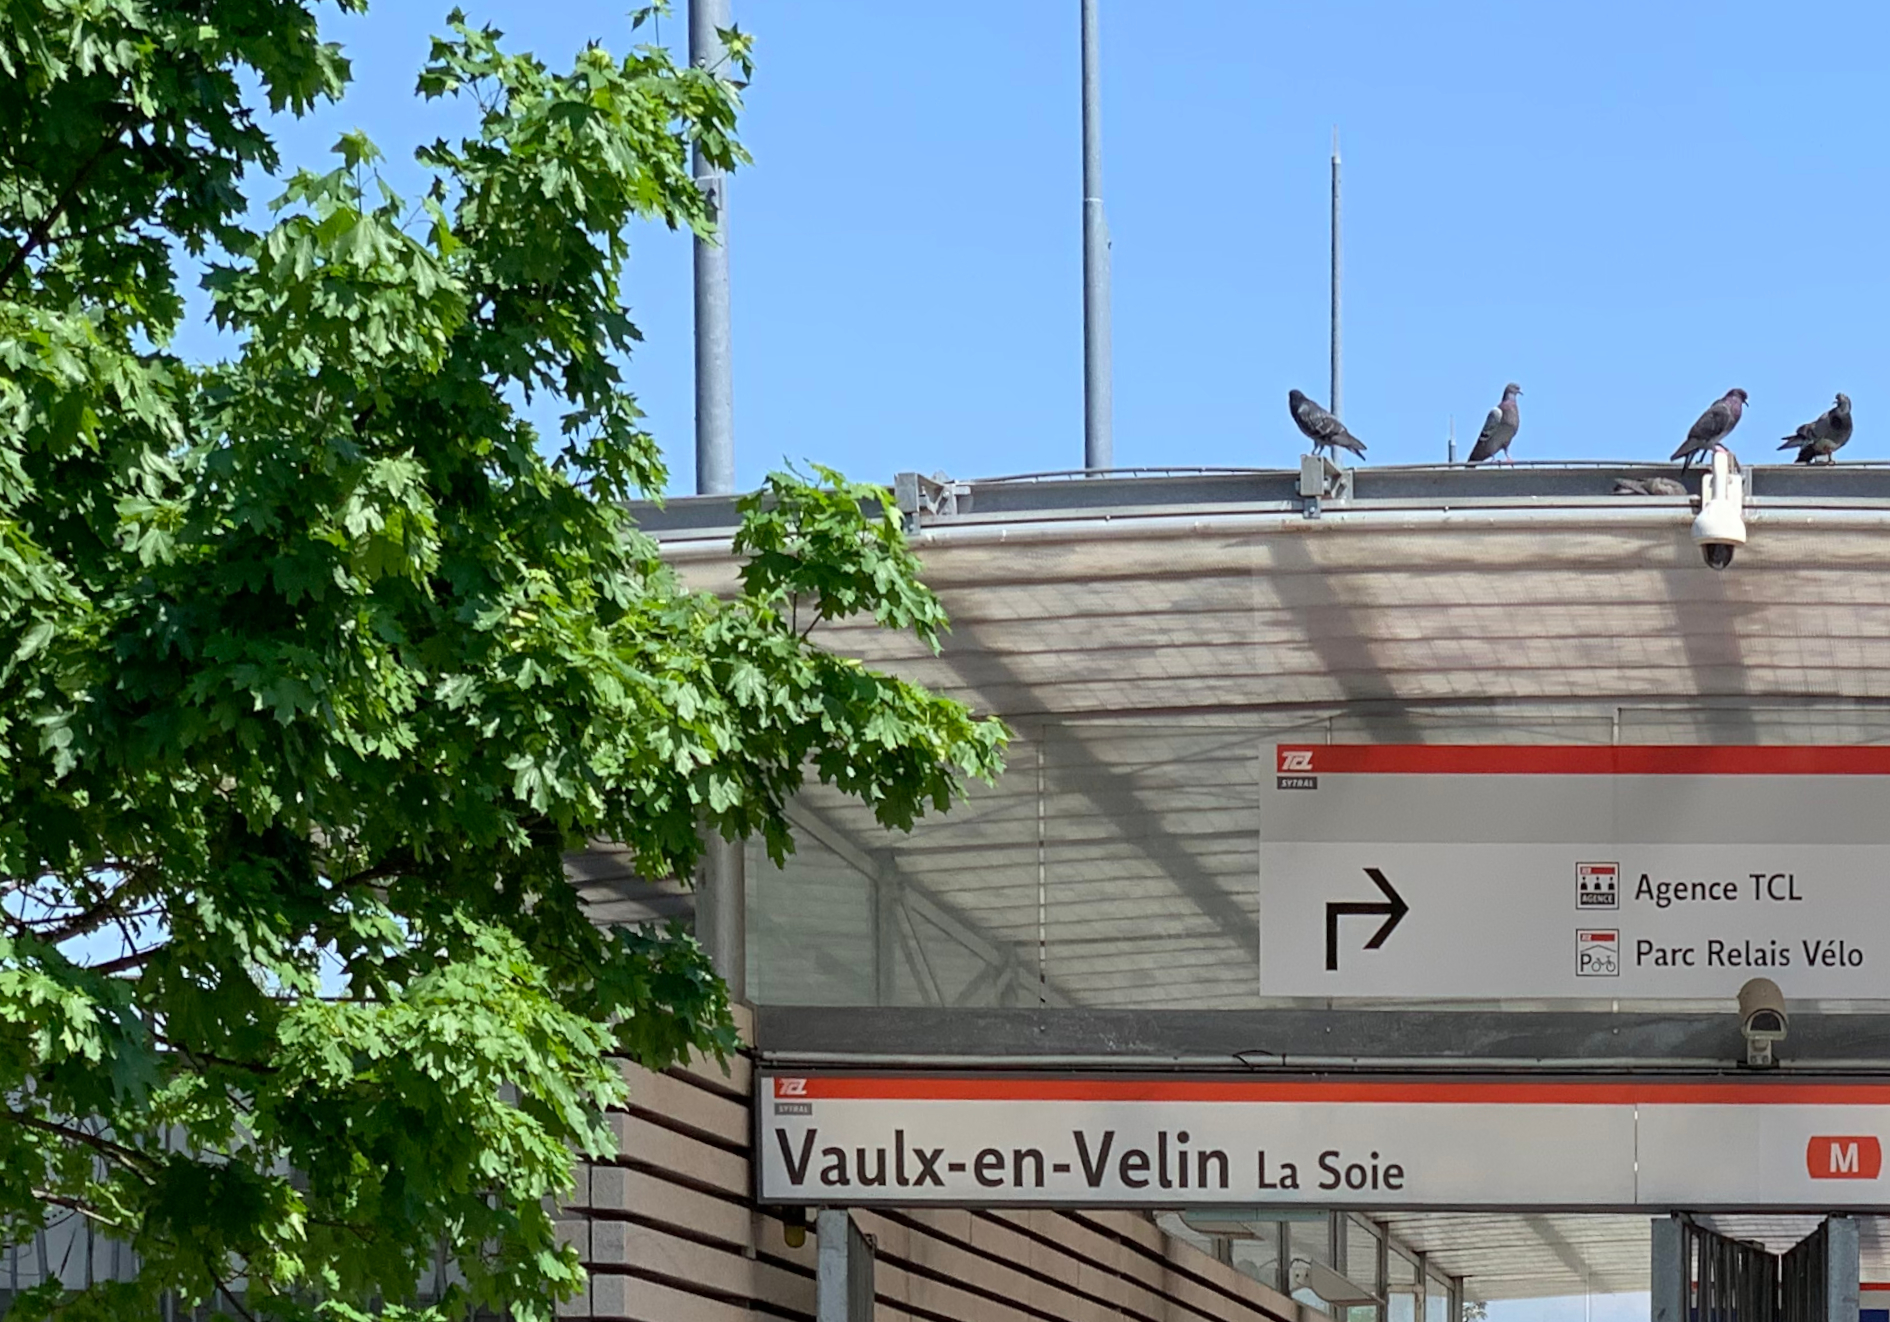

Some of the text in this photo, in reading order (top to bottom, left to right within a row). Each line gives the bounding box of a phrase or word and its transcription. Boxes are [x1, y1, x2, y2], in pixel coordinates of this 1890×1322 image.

[1280, 778, 1314, 788] SYTRAL
[1581, 893, 1614, 904] AGENCE
[1634, 873, 1802, 908] Agence TCL
[1635, 939, 1864, 967] Parc Relais Vélo
[774, 1128, 1405, 1191] Vaulx-en-Velin La Soie
[1828, 1142, 1859, 1173] M
